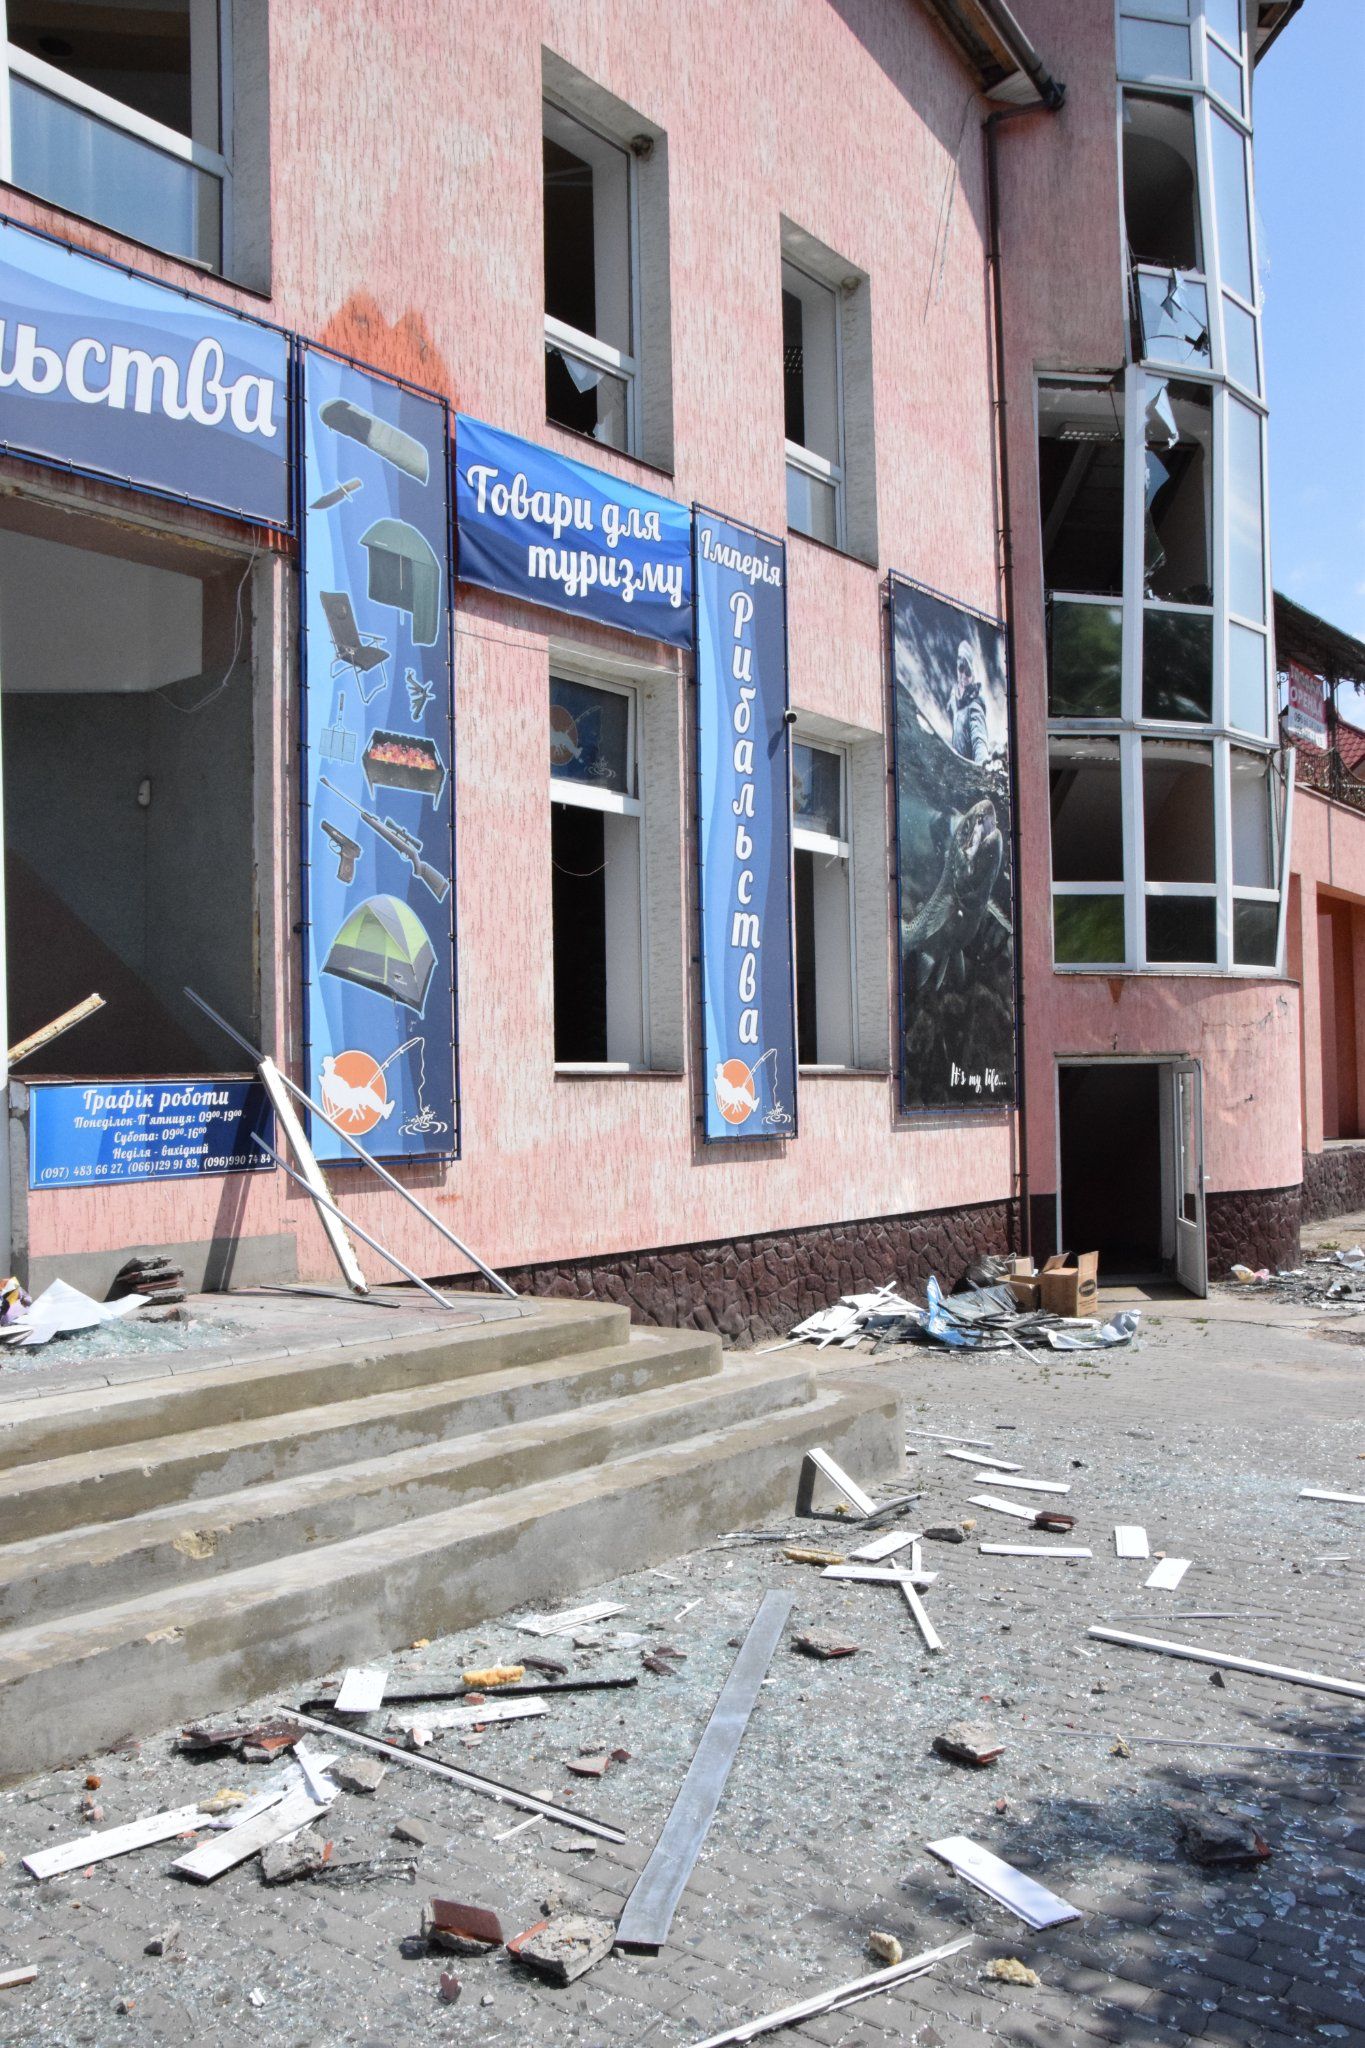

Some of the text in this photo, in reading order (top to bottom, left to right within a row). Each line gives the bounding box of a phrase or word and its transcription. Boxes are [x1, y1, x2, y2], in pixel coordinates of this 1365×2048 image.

[466, 464, 662, 548] Товари для
[701, 529, 782, 587] Імперія
[528, 545, 683, 608] туризму
[729, 591, 761, 1044] Рибальства
[950, 1062, 1007, 1094] It's my life...
[83, 1086, 230, 1116] Графік роботи
[113, 1147, 151, 1162] Неділя
[161, 1143, 209, 1159] вихідний
[114, 1131, 158, 1146] Субота:
[41, 1167, 70, 1181] (097)
[73, 1165, 92, 1177] 483
[95, 1164, 108, 1175] 66
[173, 1159, 183, 1169] 91
[260, 1153, 271, 1164] 84
